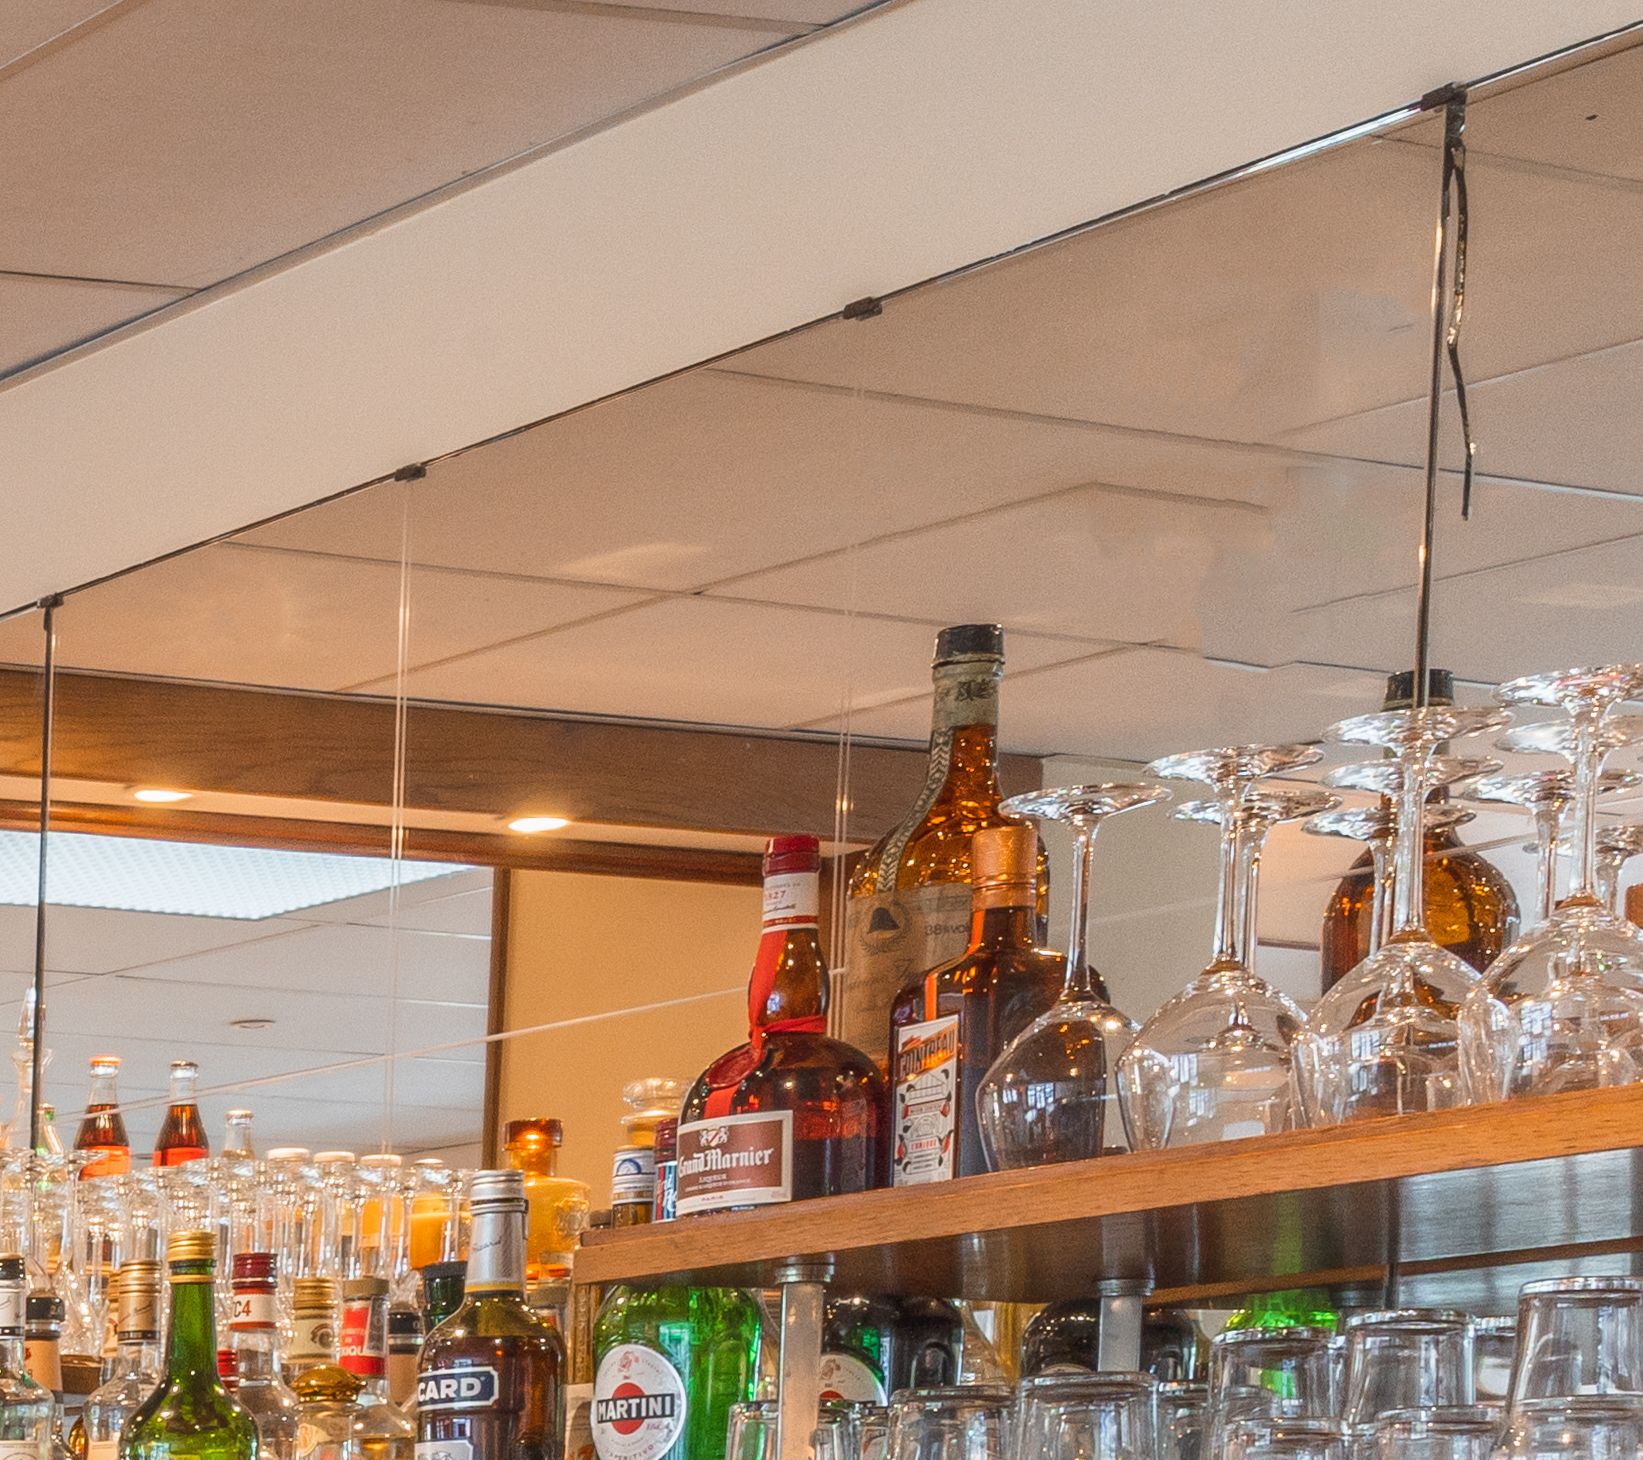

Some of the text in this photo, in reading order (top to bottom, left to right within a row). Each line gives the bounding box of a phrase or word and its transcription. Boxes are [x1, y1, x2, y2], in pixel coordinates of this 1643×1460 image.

[900, 1028, 956, 1079] COINTREAU
[704, 1146, 774, 1171] Marnier
[418, 1376, 482, 1401] CARD
[599, 1396, 672, 1421] MARTINI
